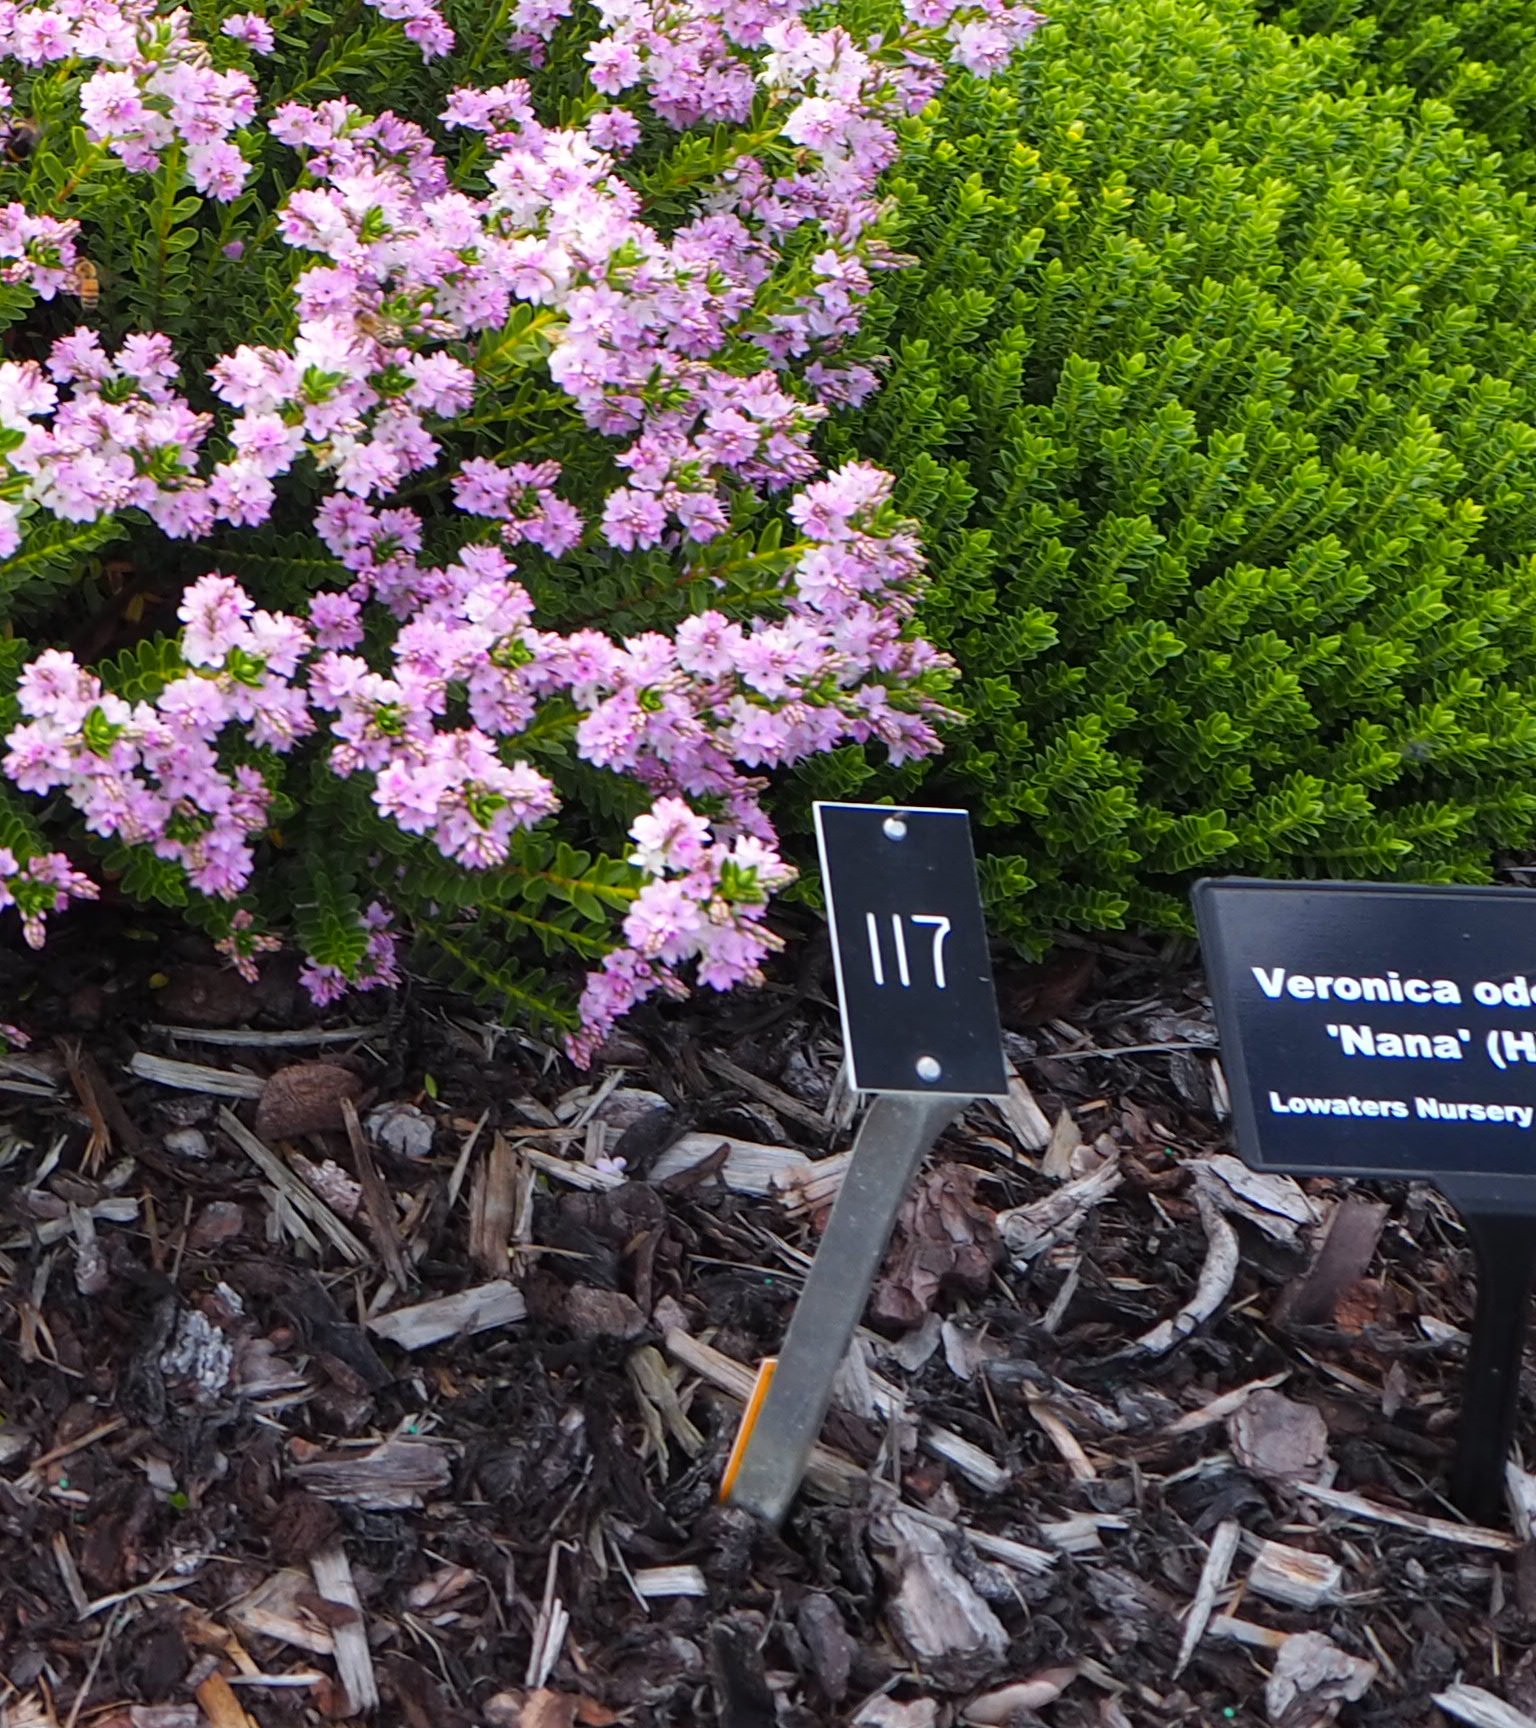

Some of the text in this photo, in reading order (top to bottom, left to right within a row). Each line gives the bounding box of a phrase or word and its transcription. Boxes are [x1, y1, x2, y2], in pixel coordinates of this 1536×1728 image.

[865, 911, 951, 989] 117
[1250, 966, 1536, 1007] Veronica od
[1325, 1023, 1536, 1070] 'Nana' (H
[1268, 1090, 1534, 1128] Lowaters Nursery
